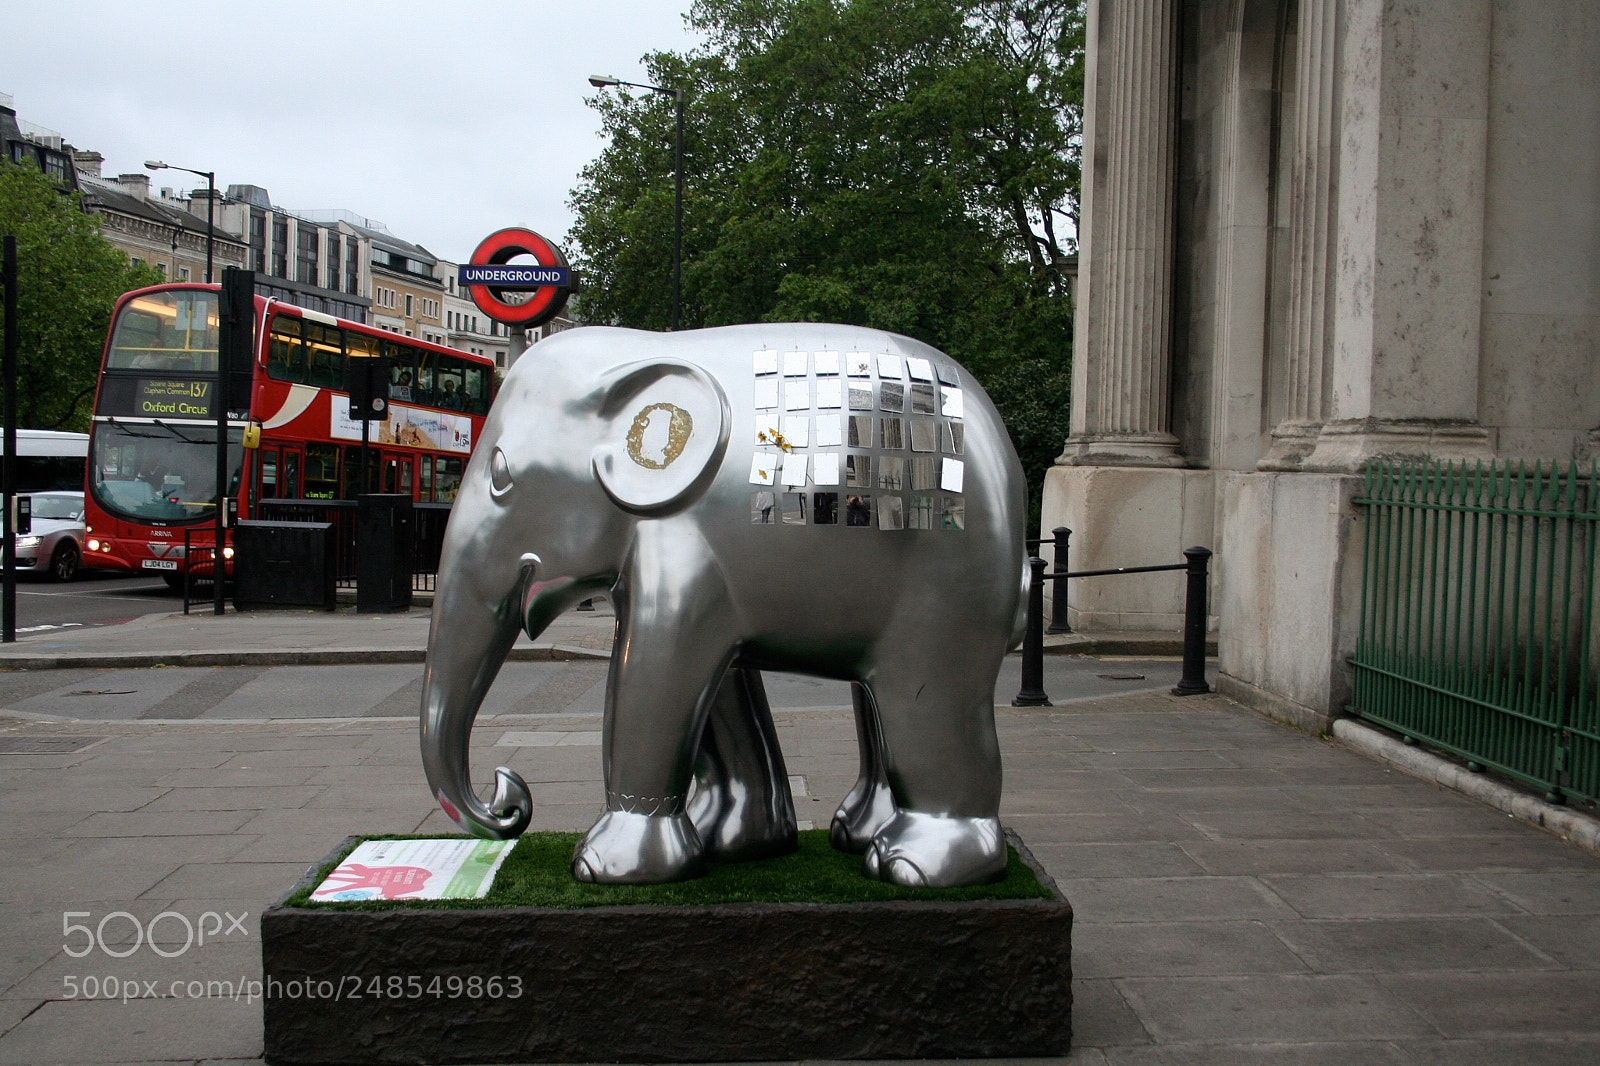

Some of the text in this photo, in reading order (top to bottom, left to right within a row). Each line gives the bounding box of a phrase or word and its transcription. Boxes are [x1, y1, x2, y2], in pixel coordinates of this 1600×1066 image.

[466, 270, 560, 281] UNDERGROUND
[167, 381, 185, 389] Square
[190, 381, 209, 398] 137
[143, 387, 166, 395] Clapham
[142, 401, 208, 414] Oxford Circus
[150, 530, 173, 538] ARRIVA
